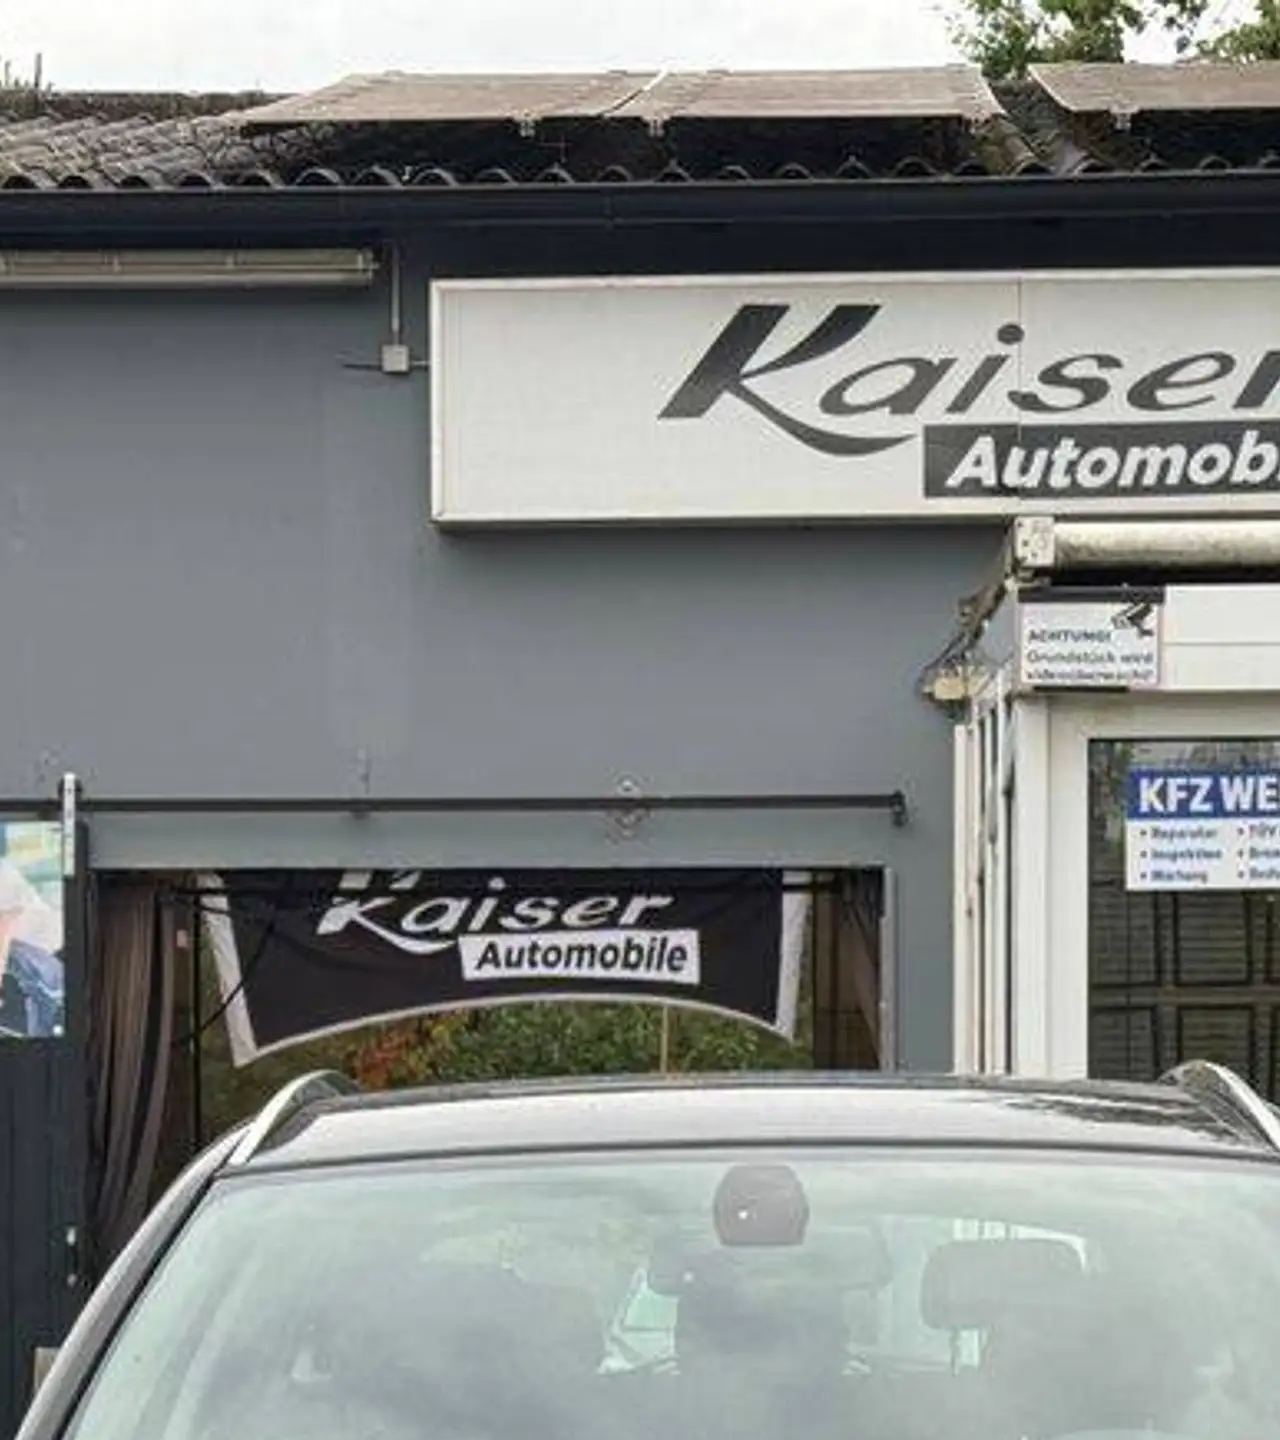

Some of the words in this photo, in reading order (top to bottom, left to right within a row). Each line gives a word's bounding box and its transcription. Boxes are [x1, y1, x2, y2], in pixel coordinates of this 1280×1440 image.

[1138, 776, 1214, 814] KFZ
[317, 869, 673, 955] Kaiser
[474, 937, 688, 972] Automobile
